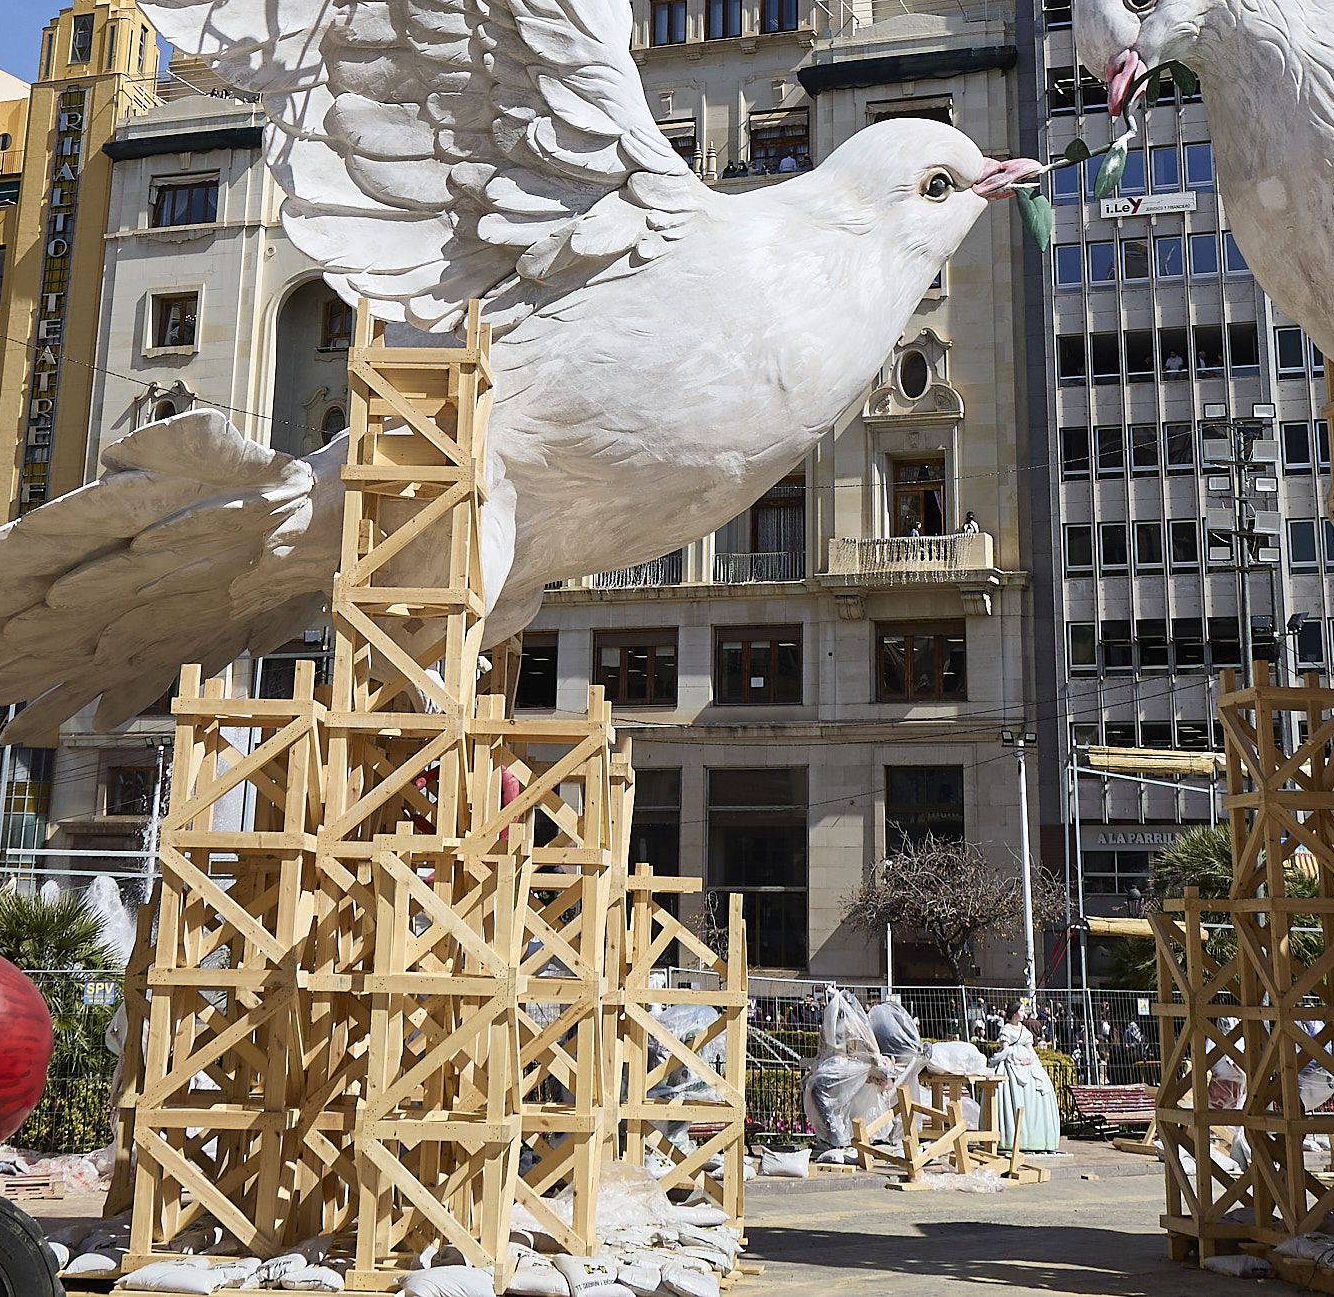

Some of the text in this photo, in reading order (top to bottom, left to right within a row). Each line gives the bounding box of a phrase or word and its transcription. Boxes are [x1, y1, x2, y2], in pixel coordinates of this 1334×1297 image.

[48, 111, 82, 258] RIALTO
[27, 293, 64, 446] TEATRE
[1098, 833, 1107, 844] A
[1108, 833, 1126, 844] LA
[87, 983, 114, 994] SPV
